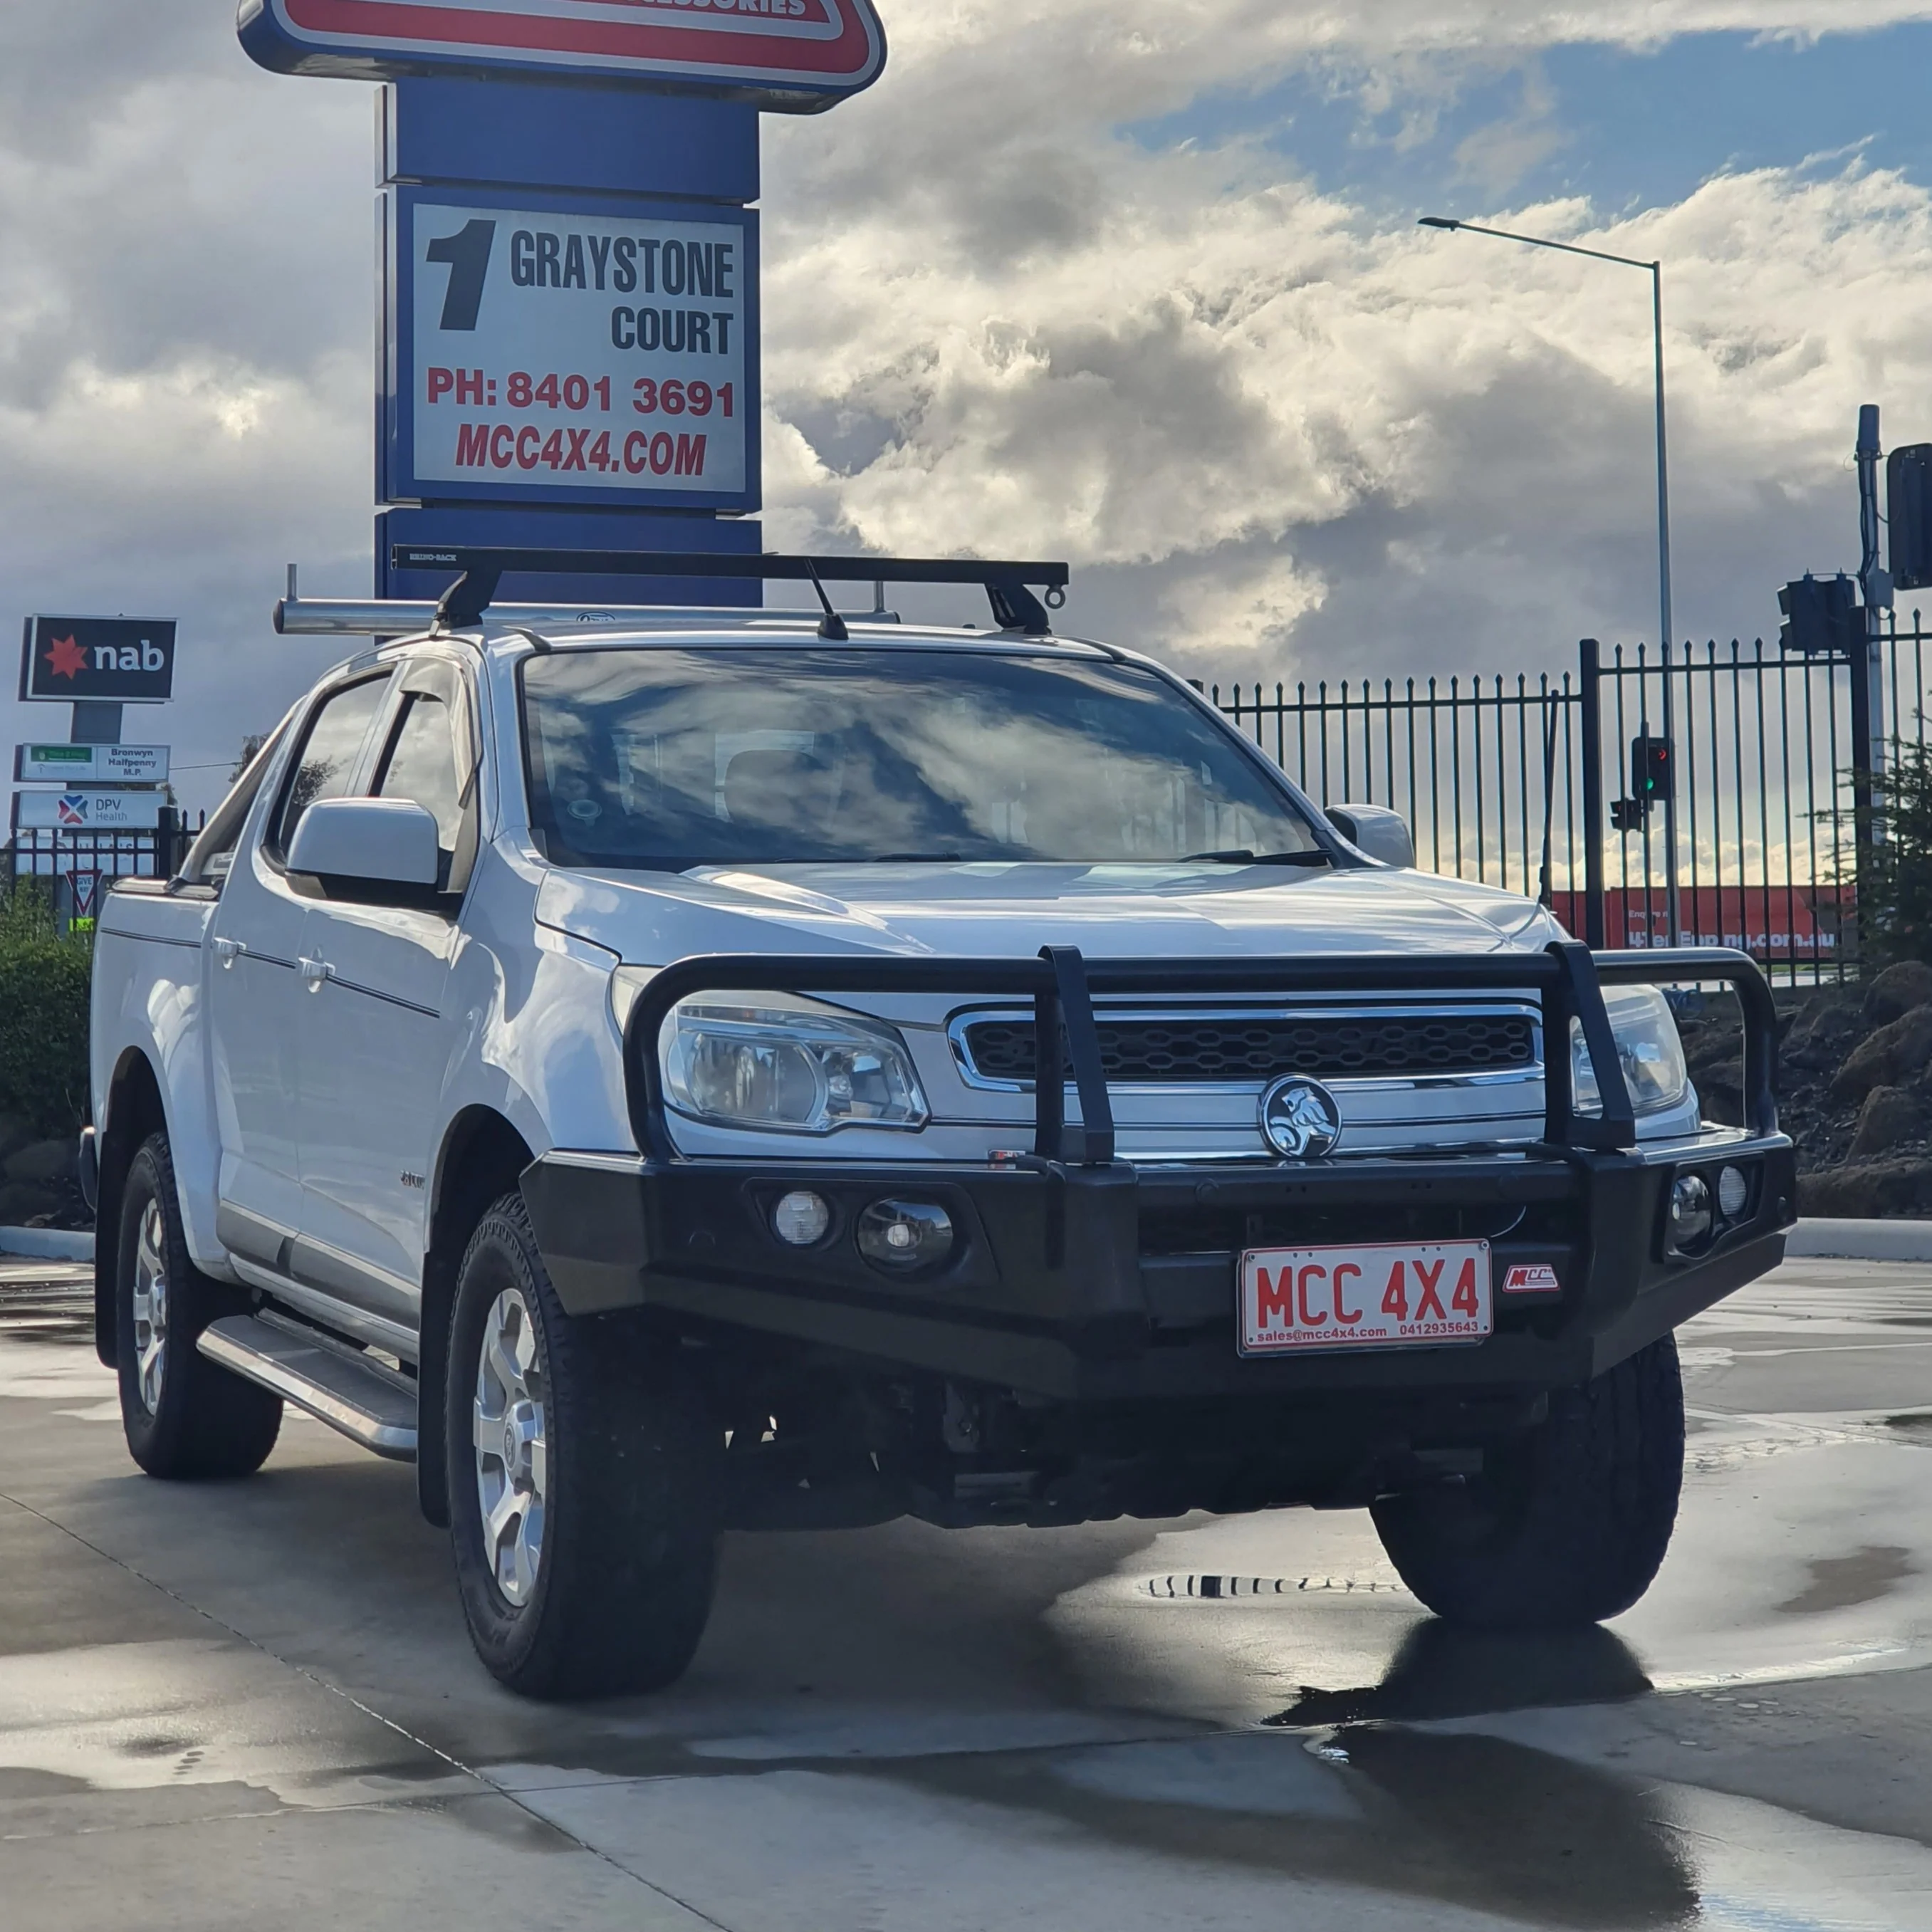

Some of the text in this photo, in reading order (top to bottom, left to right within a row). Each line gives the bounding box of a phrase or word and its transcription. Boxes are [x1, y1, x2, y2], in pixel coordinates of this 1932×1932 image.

[426, 219, 733, 331] 1 GRAYSTONE
[611, 306, 733, 355] COURT
[427, 367, 733, 417] PH: 8401 3691
[455, 423, 707, 476] MCC4X4.COM
[94, 639, 165, 672] nab
[108, 758, 156, 768] Halfpenny
[111, 748, 153, 758] Bronwyn
[95, 798, 121, 810] DPV
[95, 812, 127, 821] Health
[1509, 1268, 1553, 1286] MCC
[1257, 1258, 1478, 1328] MCC 4X4
[1258, 1322, 1478, 1342] sales@mcc4x4.com 0412935643
